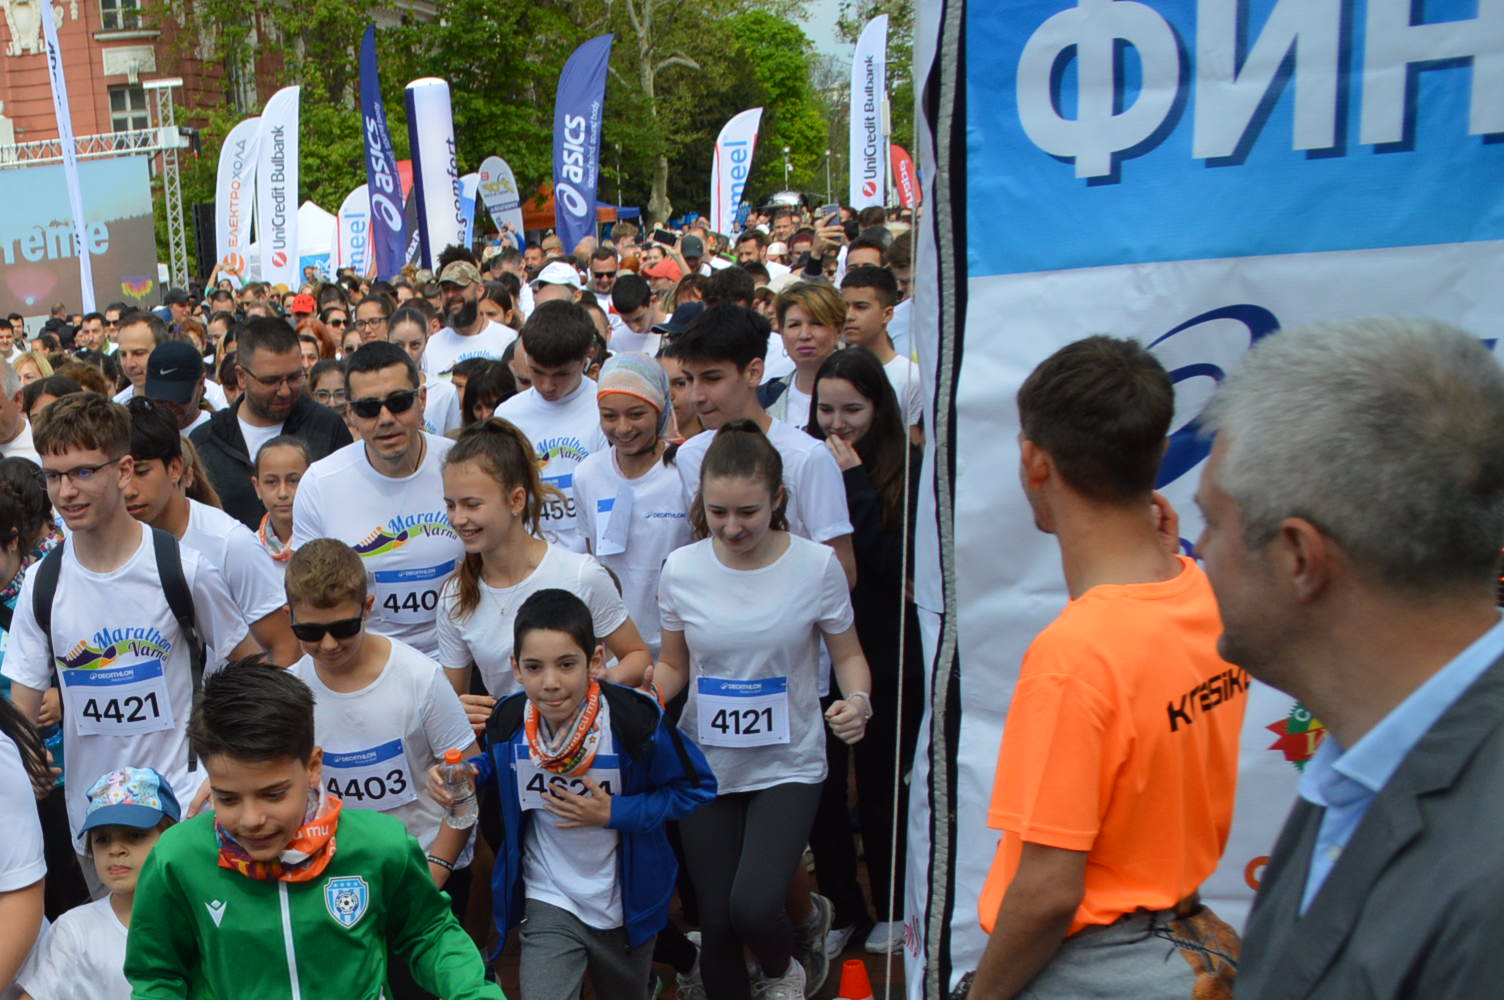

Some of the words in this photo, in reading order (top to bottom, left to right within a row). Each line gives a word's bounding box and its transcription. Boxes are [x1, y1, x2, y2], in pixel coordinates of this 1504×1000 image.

[863, 55, 874, 114] Bulbank
[271, 125, 286, 183] Bulbank
[863, 122, 877, 180] UniCredit
[271, 186, 287, 250] UniCredit
[559, 446, 584, 463] Varn
[383, 589, 439, 614] 440
[93, 626, 172, 653] Marathon
[127, 640, 169, 662] Varna
[83, 691, 160, 724] 4421
[710, 706, 773, 735] 4121
[327, 768, 407, 801] 4403
